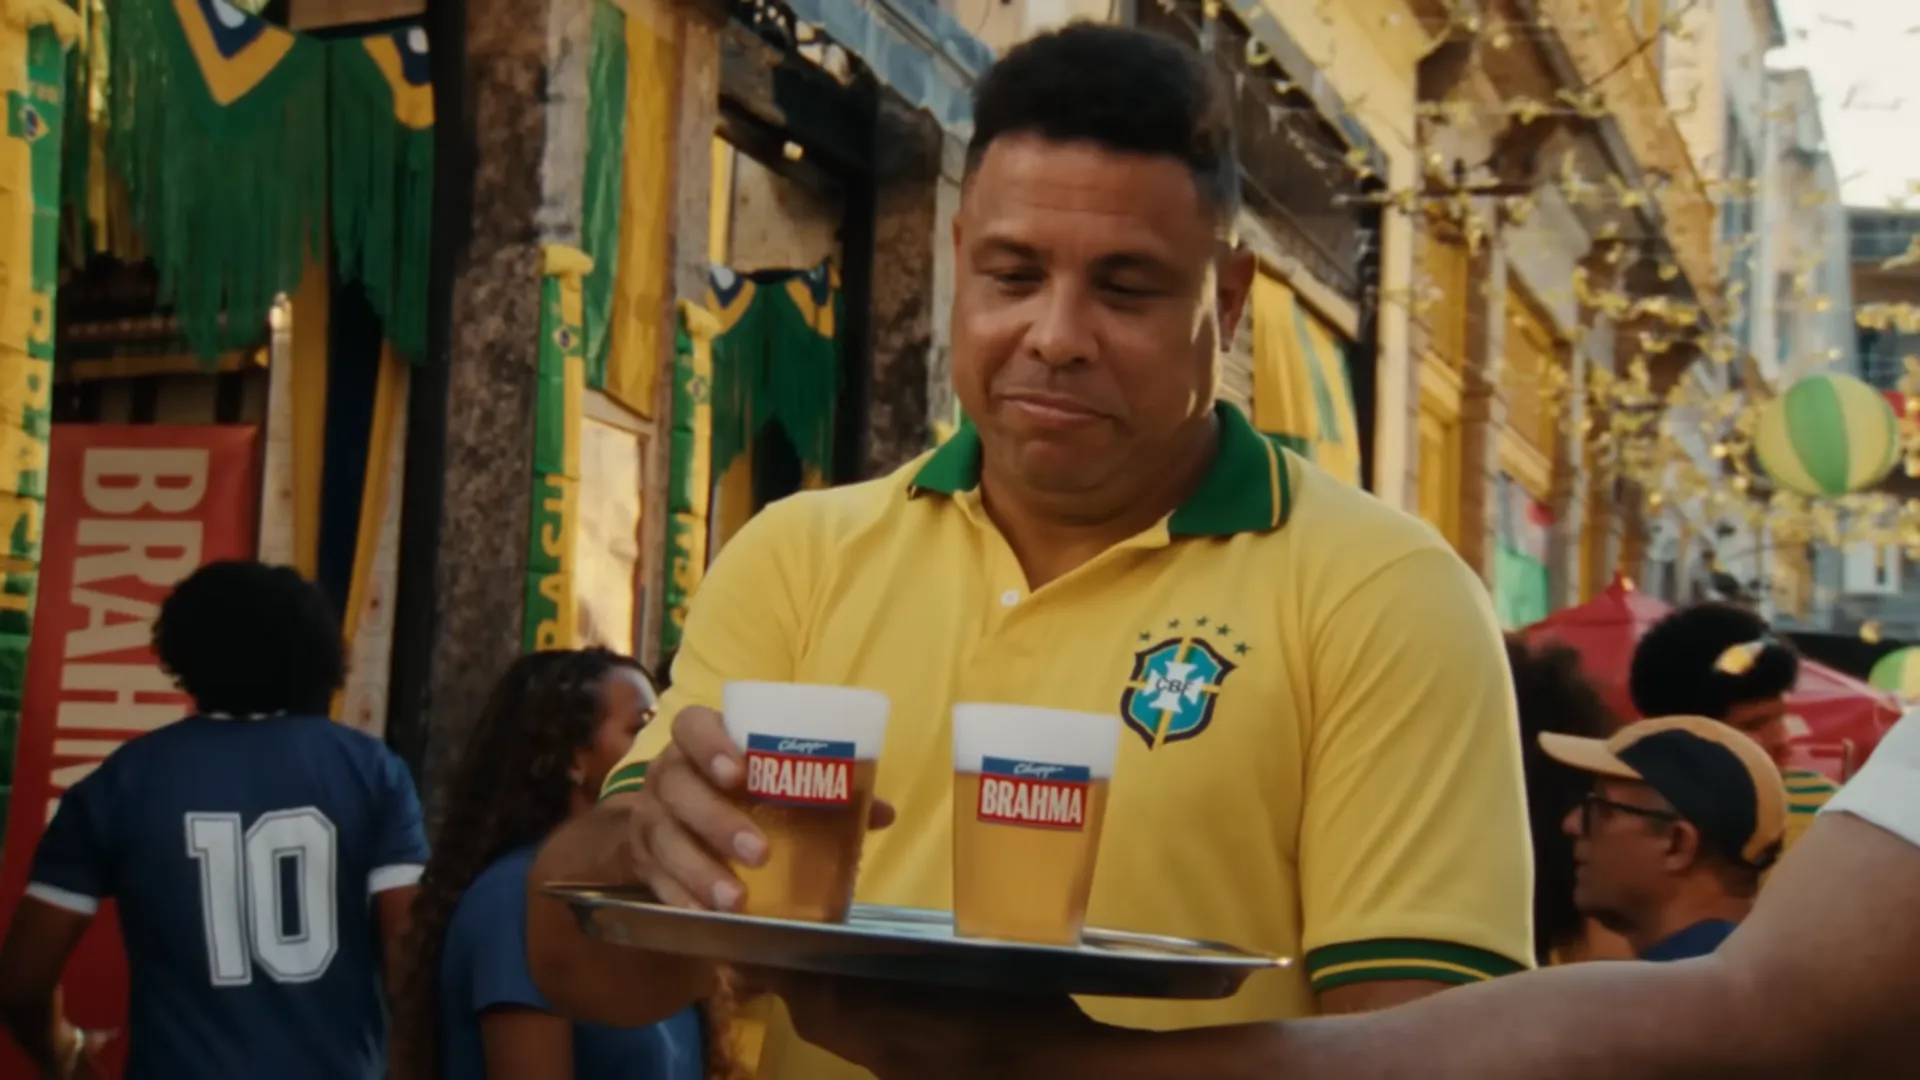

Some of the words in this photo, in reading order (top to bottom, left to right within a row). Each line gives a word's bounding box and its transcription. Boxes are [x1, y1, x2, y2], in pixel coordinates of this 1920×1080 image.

[47, 448, 209, 826] BRAH
[1155, 677, 1192, 696] CBF
[747, 755, 847, 800] BRAHMA
[981, 778, 1081, 824] BRAHMA
[184, 806, 338, 987] 10
